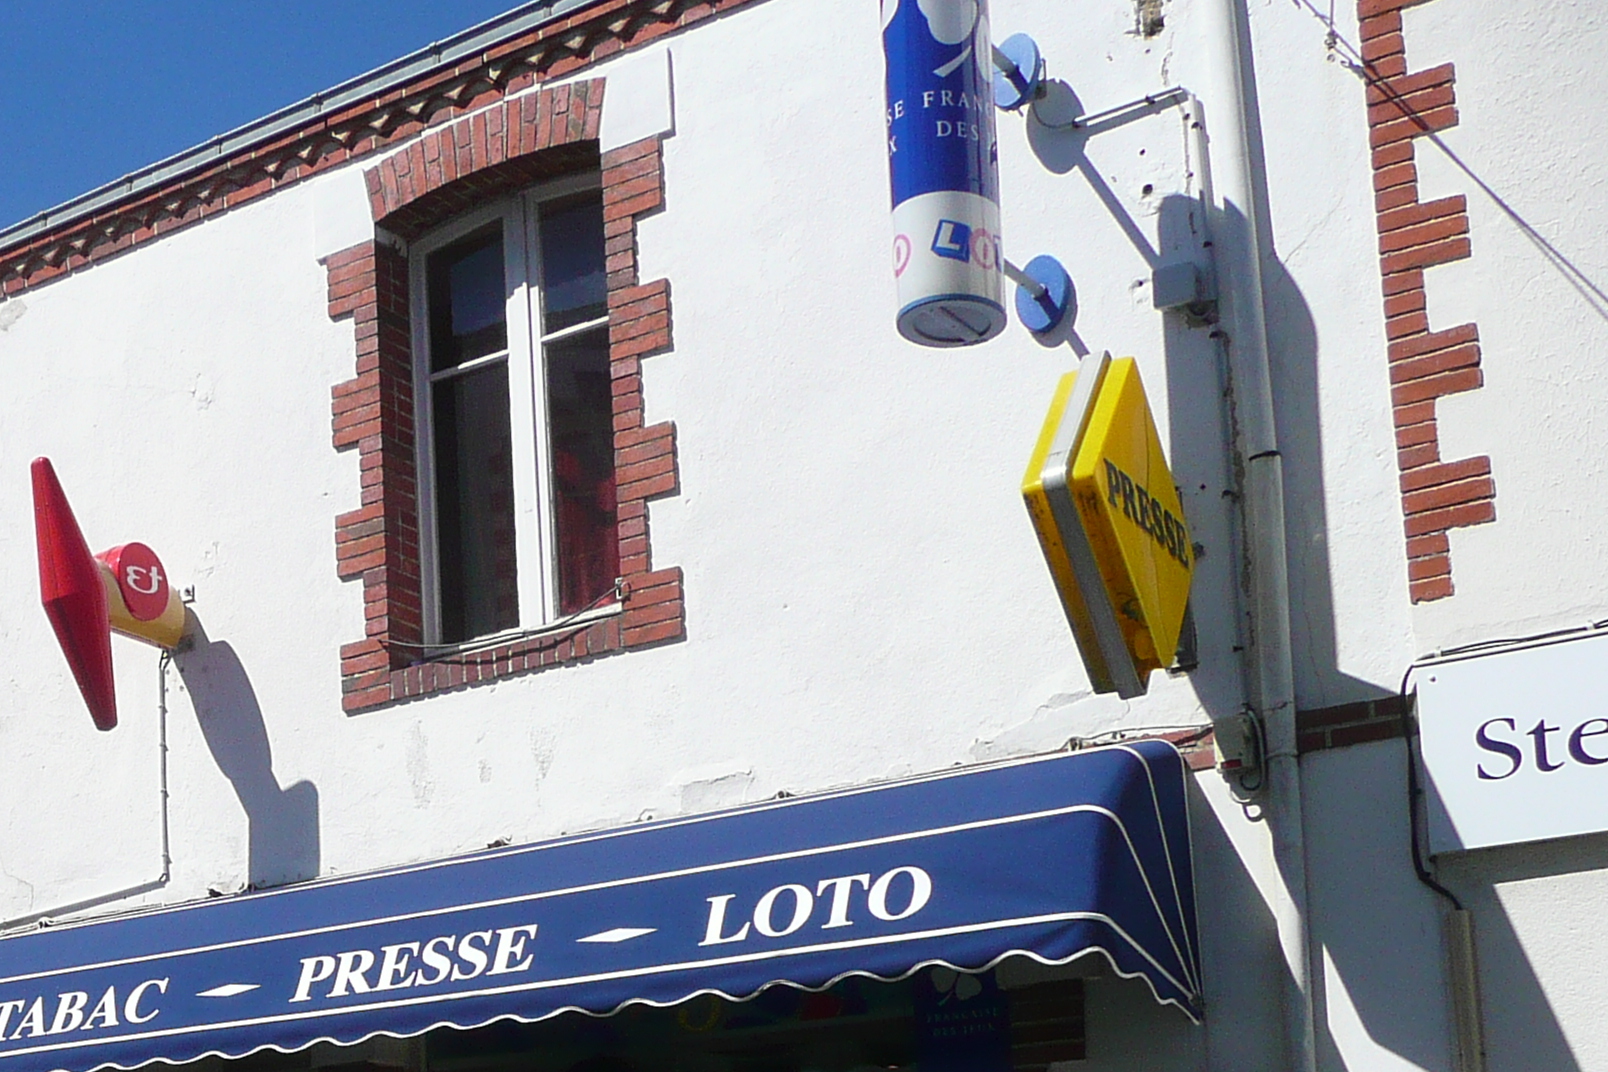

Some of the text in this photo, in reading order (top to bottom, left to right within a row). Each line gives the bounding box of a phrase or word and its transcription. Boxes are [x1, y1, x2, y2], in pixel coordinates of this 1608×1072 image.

[935, 120, 980, 141] DES
[1103, 457, 1190, 570] PRESSE
[1475, 717, 1608, 780] Ste
[288, 924, 539, 1003] PRESSE
[697, 866, 932, 947] LOTO
